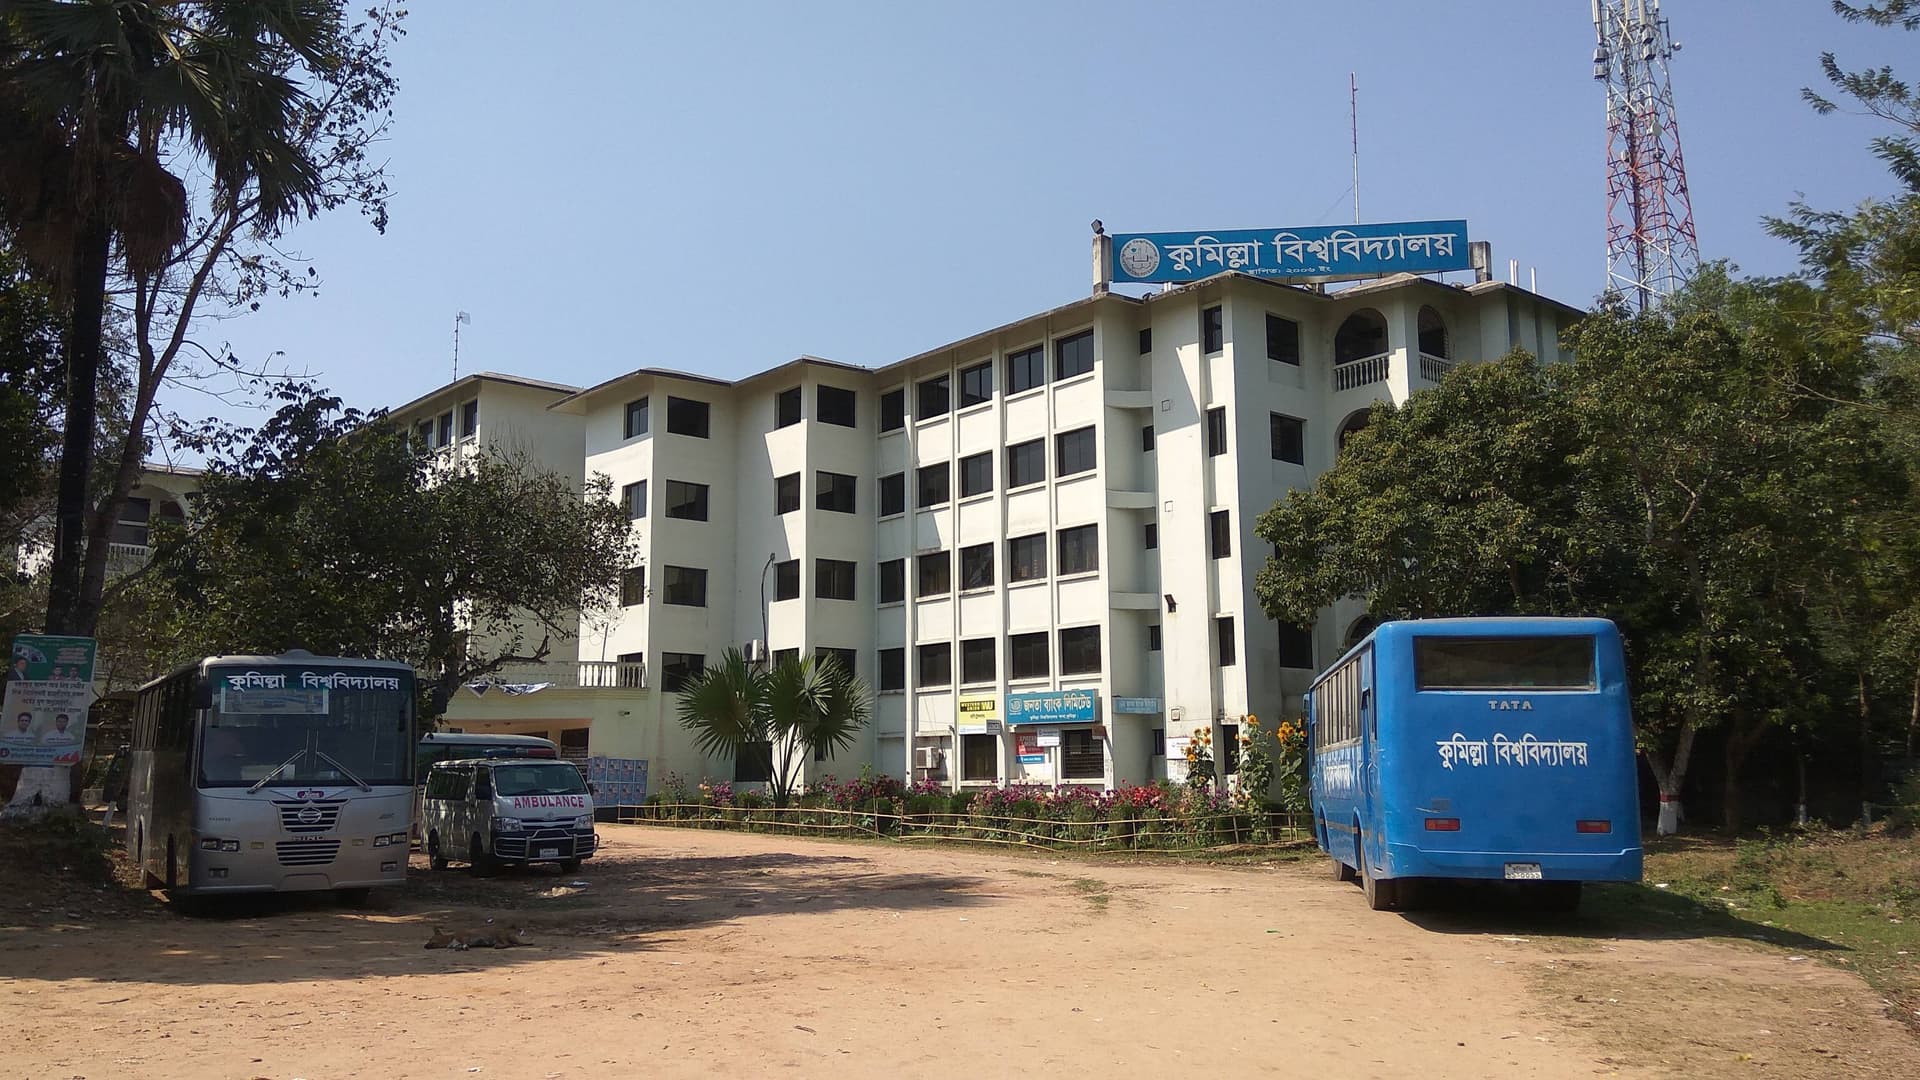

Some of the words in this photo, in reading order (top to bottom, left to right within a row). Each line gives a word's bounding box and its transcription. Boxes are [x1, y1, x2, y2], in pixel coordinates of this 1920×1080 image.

[1164, 236, 1263, 272] কুমিল্লা
[1272, 231, 1457, 264] বিশ্ববিদ্যালয়
[227, 671, 287, 692] কুমিল্লা
[301, 671, 400, 691] বিশ্ববিদ্যালয়
[1023, 699, 1042, 712] জনতা
[1063, 692, 1092, 710] লিমিটেড
[1488, 700, 1533, 711] TATA
[1437, 733, 1489, 770] কুমিল্লা
[1492, 733, 1588, 767] বিশ্ববিদ্যালয়
[514, 796, 585, 809] AMBULANCE
